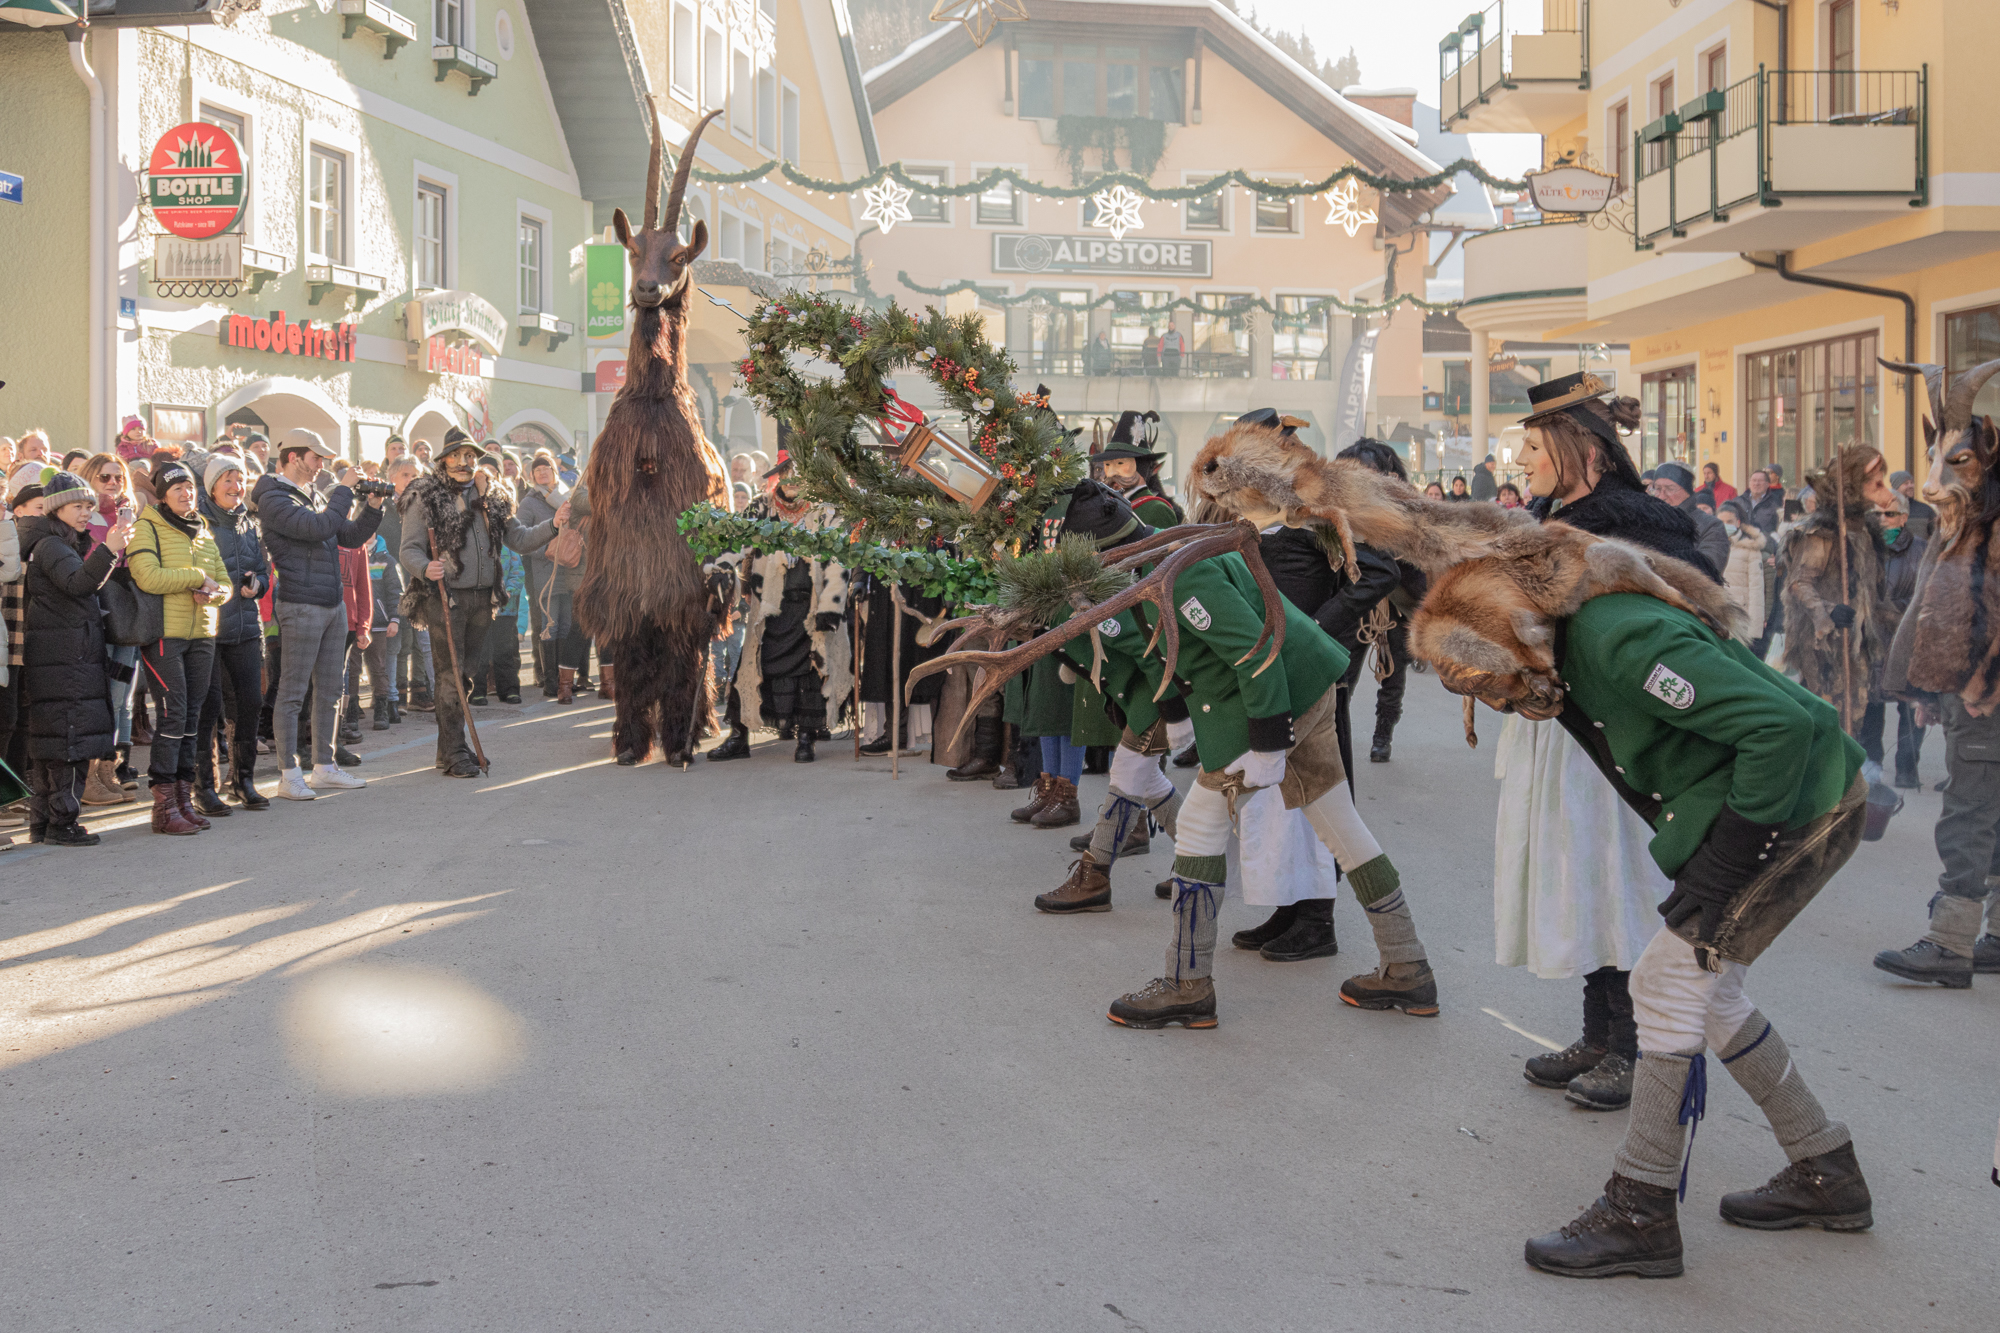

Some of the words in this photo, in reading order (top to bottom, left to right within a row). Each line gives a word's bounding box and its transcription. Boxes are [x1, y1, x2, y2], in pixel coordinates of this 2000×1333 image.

[156, 177, 234, 196] BOTTLE
[1539, 189, 1563, 197] ALTE
[1582, 189, 1606, 197] POST
[178, 196, 212, 205] SHOP
[1054, 240, 1193, 266] ALPSTORE
[125, 300, 131, 312] 8
[589, 316, 624, 327] ADEG
[228, 310, 357, 363] modetreff
[428, 335, 482, 376] Markt
